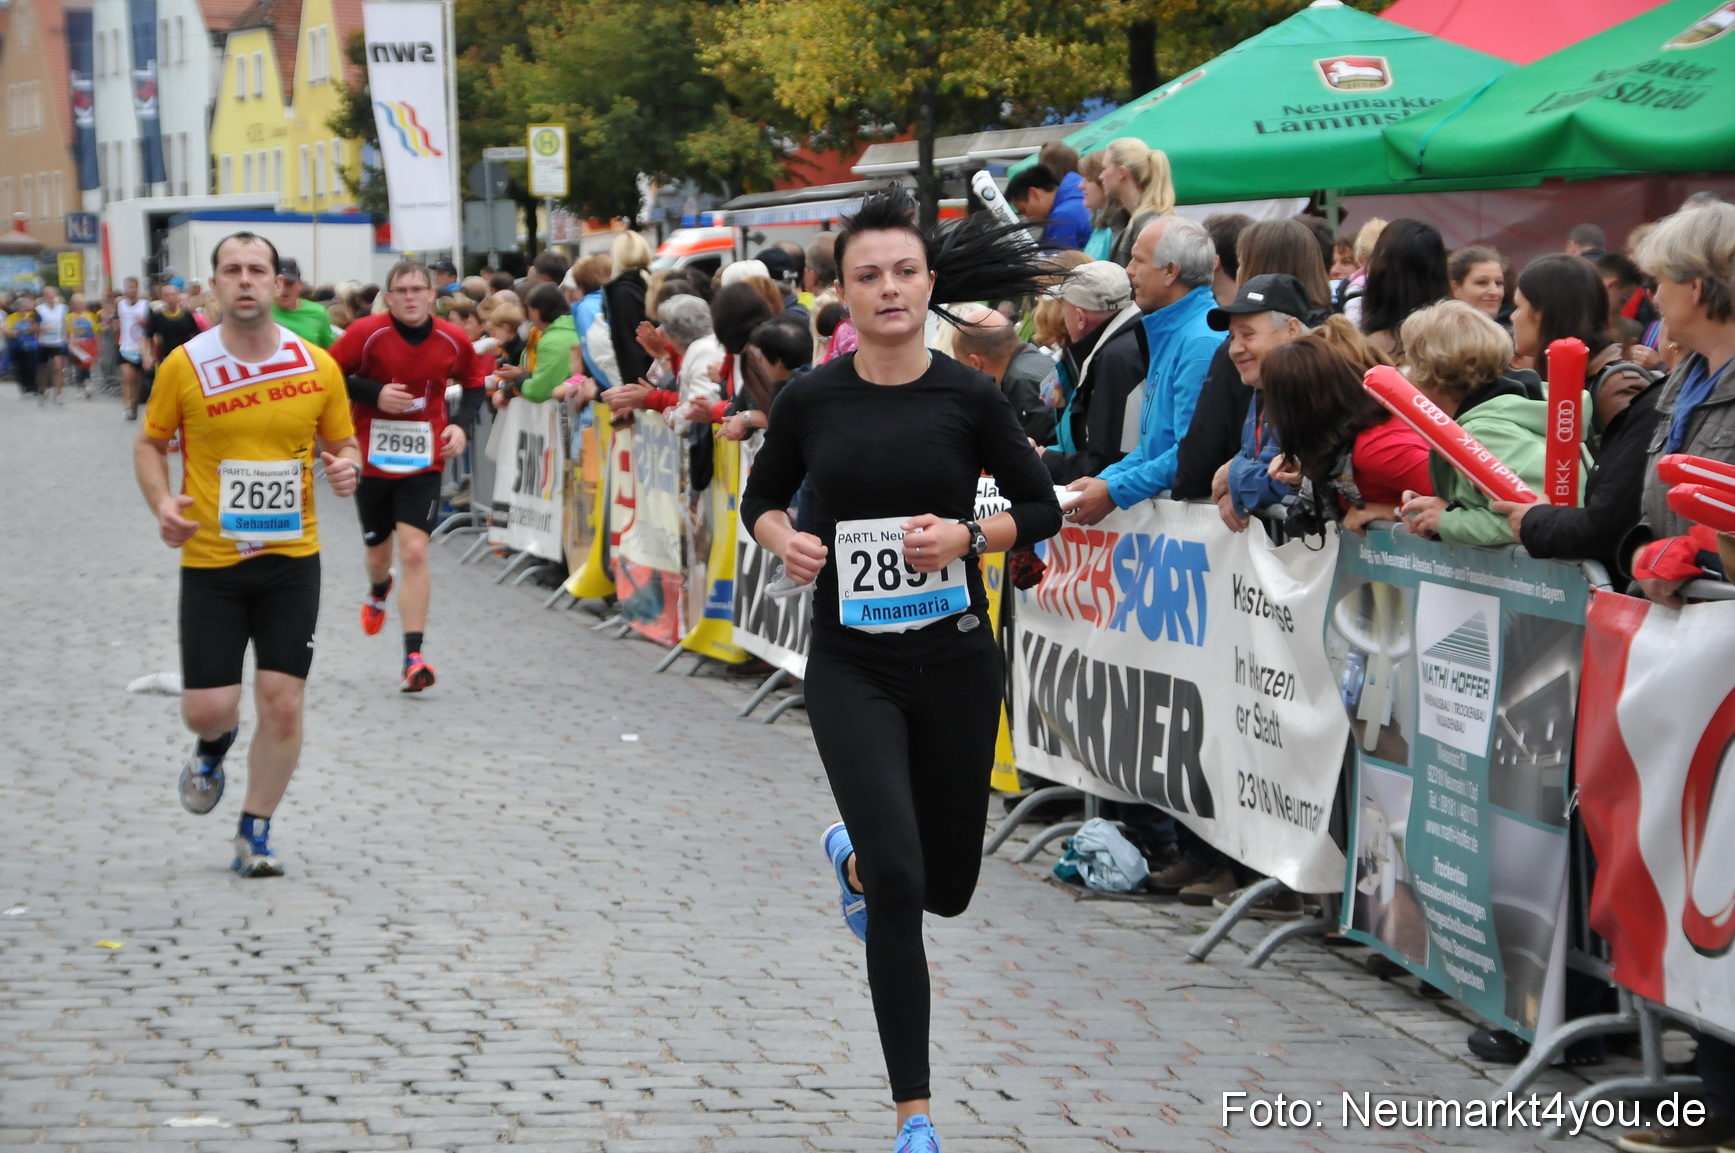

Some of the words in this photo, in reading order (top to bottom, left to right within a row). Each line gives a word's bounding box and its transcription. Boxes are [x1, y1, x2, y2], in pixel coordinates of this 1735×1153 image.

[1282, 96, 1443, 116] Neumarkte
[1253, 109, 1413, 134] Lamms
[206, 391, 261, 418] MAX
[267, 379, 323, 402] BÖGL
[376, 433, 426, 454] 2698
[1457, 433, 1492, 463] BKK
[222, 467, 252, 477] PARTL
[253, 469, 290, 477] Neumarkt
[1489, 462, 1531, 493] Audi
[1555, 459, 1571, 496] BKK
[228, 480, 295, 510] 2625
[235, 517, 290, 530] Sebastian
[837, 532, 878, 544] PARTL
[880, 530, 906, 541] Neu
[1542, 582, 1566, 604] Bayern
[860, 596, 951, 621] Annamaria
[1450, 669, 1490, 700] HOFFER
[1433, 855, 1468, 888] Trockenbau
